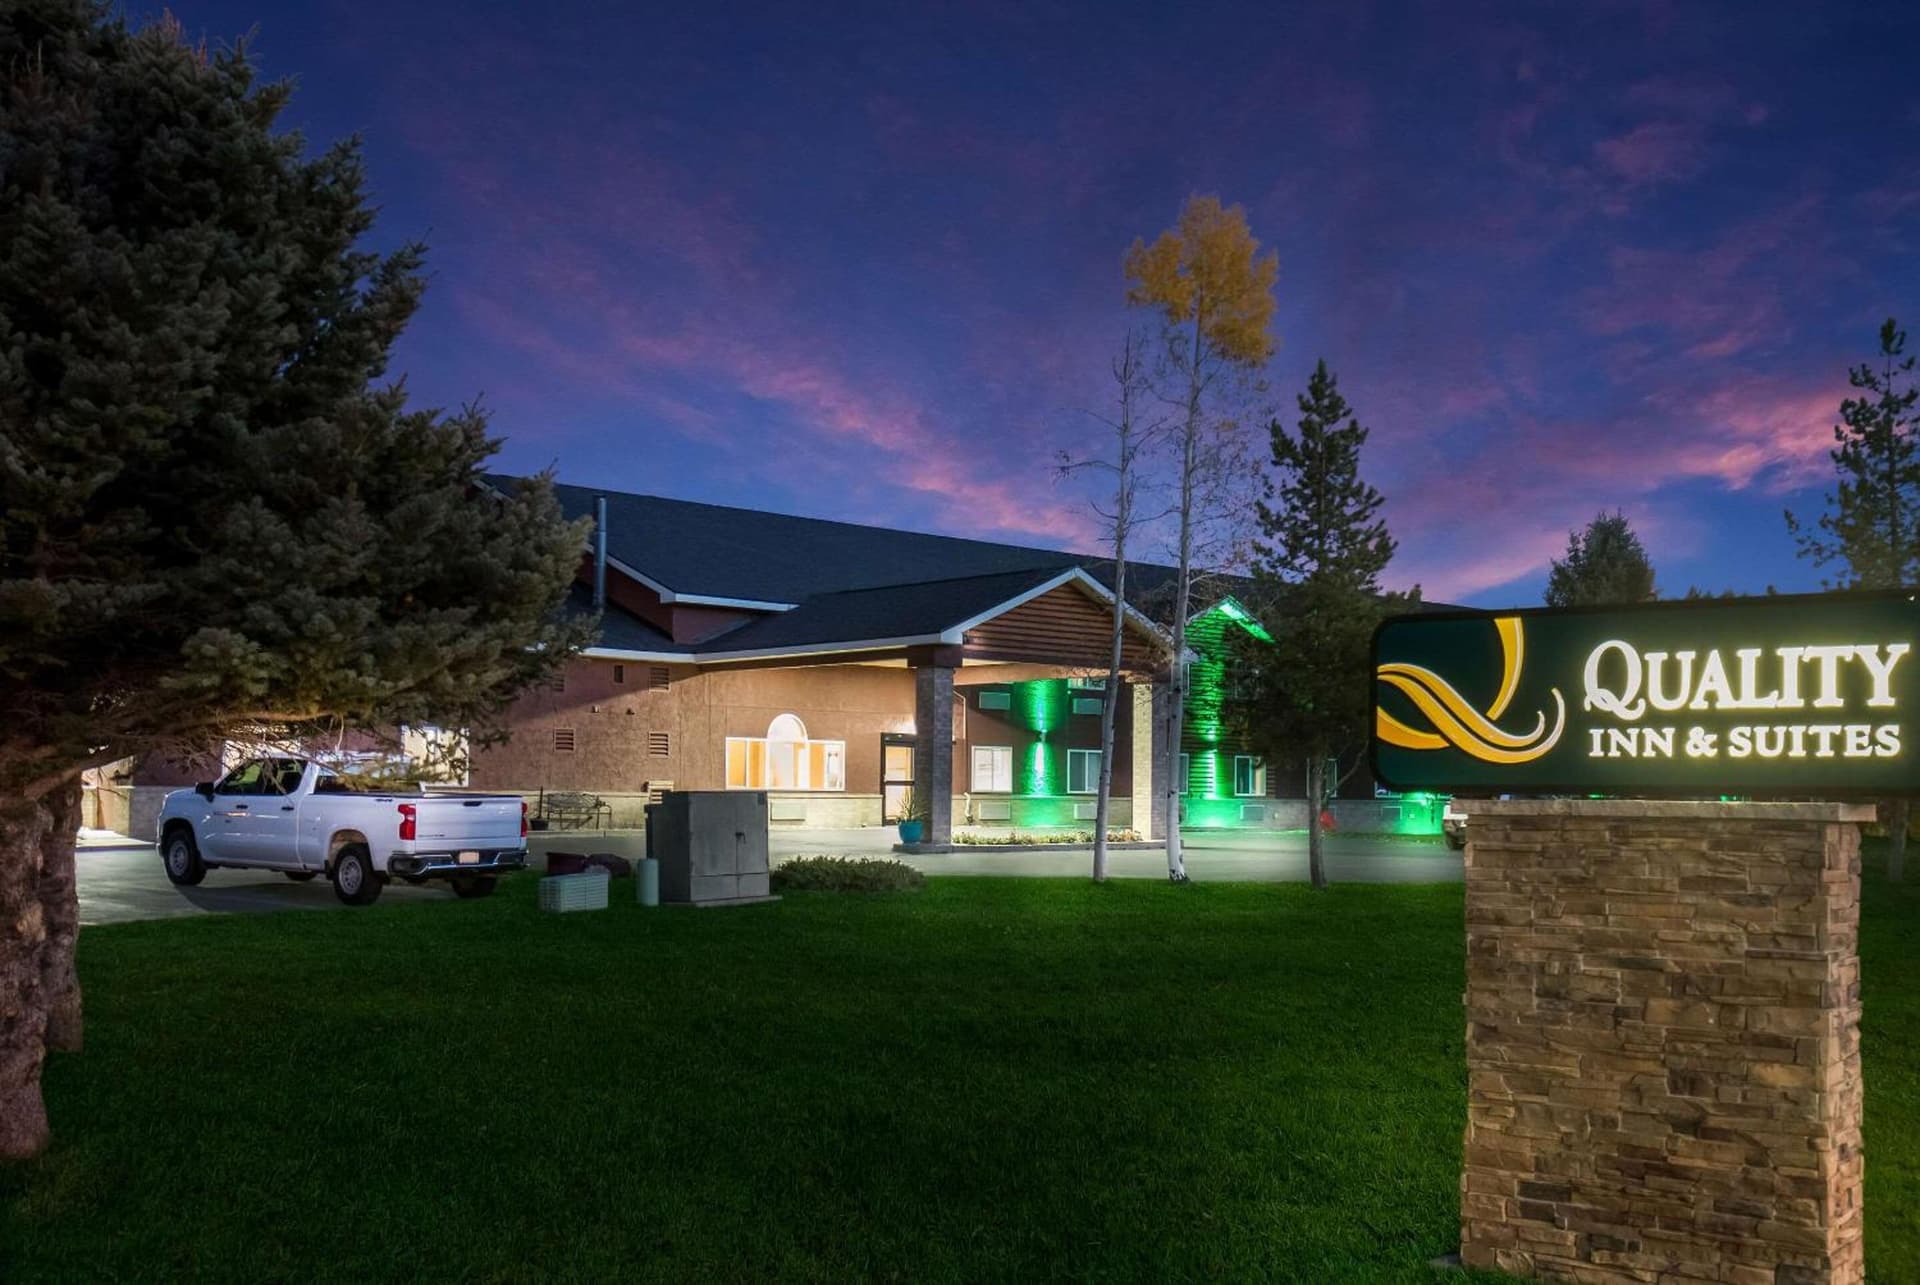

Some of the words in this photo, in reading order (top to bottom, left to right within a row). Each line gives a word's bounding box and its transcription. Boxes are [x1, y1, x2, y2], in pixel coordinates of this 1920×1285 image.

[1583, 640, 1910, 720] QUALITY
[1588, 727, 1675, 758] INN
[1685, 726, 1718, 758] &
[1728, 724, 1902, 757] SUITES
